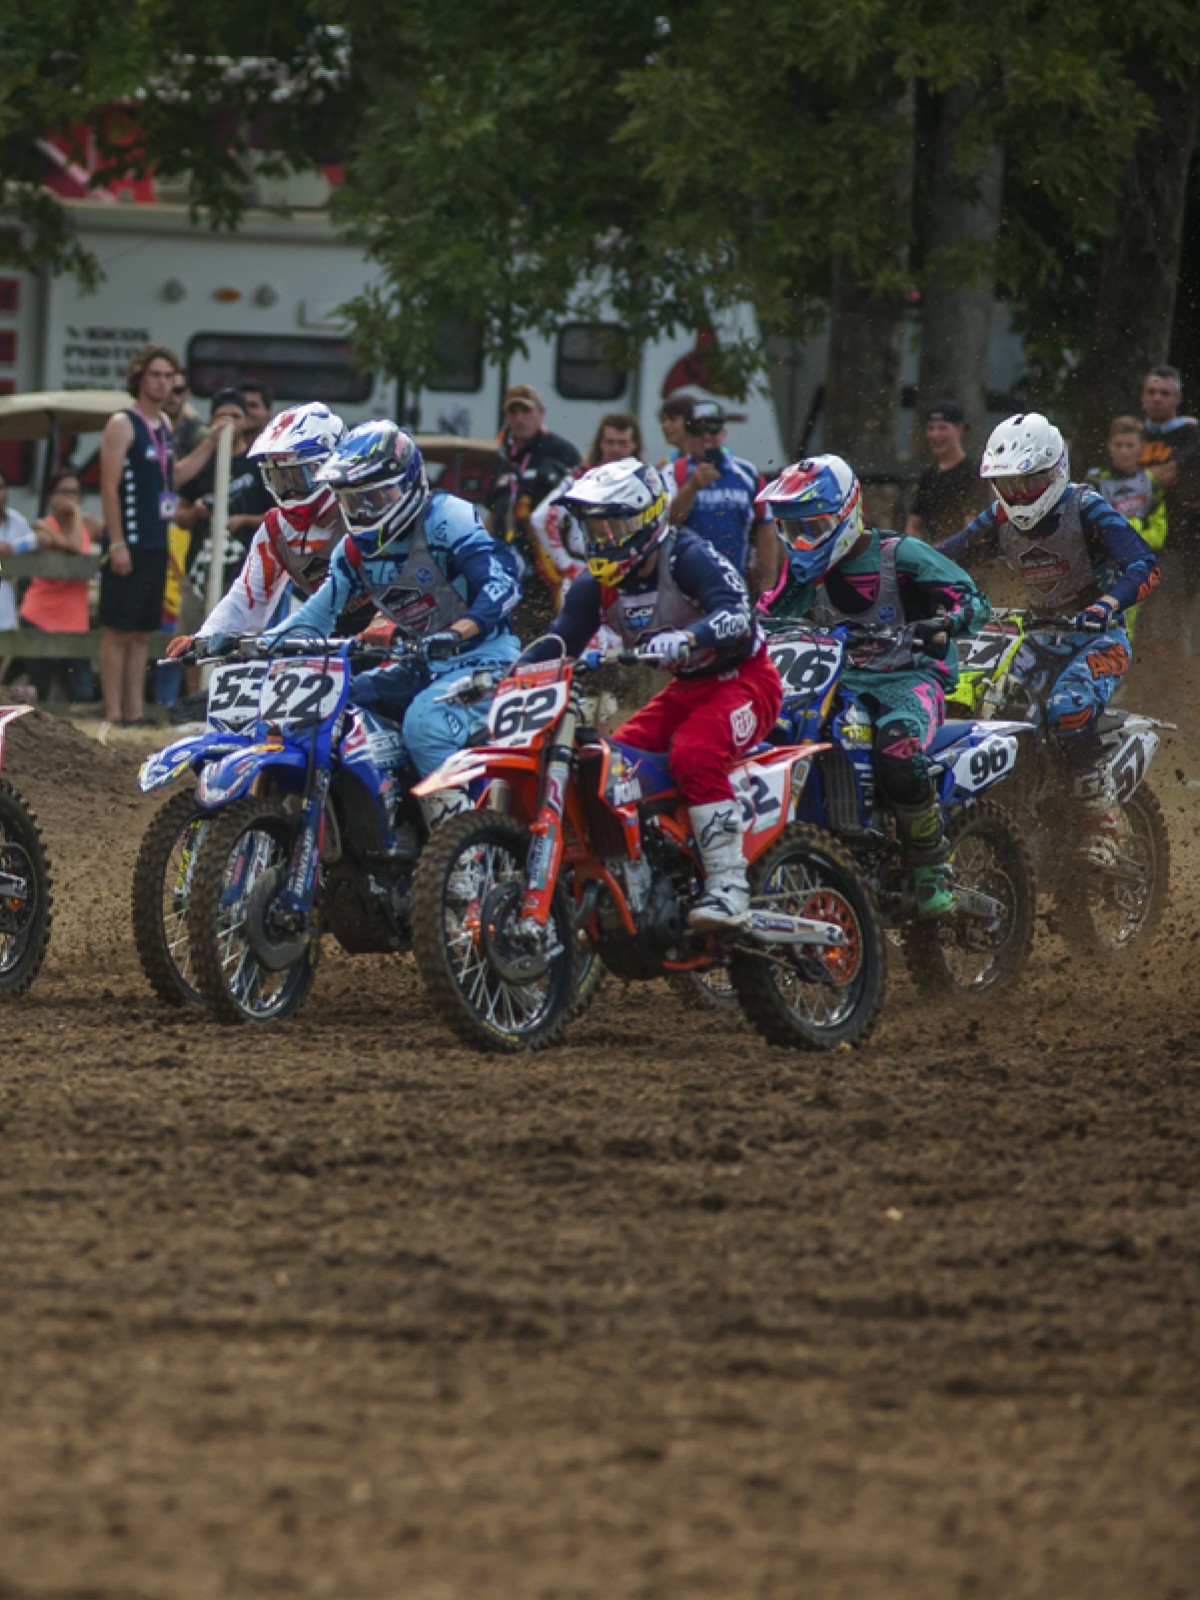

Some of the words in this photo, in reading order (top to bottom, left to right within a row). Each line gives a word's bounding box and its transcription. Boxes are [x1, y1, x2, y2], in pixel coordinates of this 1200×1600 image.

[262, 672, 335, 720] 22
[494, 686, 558, 740] 62
[969, 740, 1009, 786] 96
